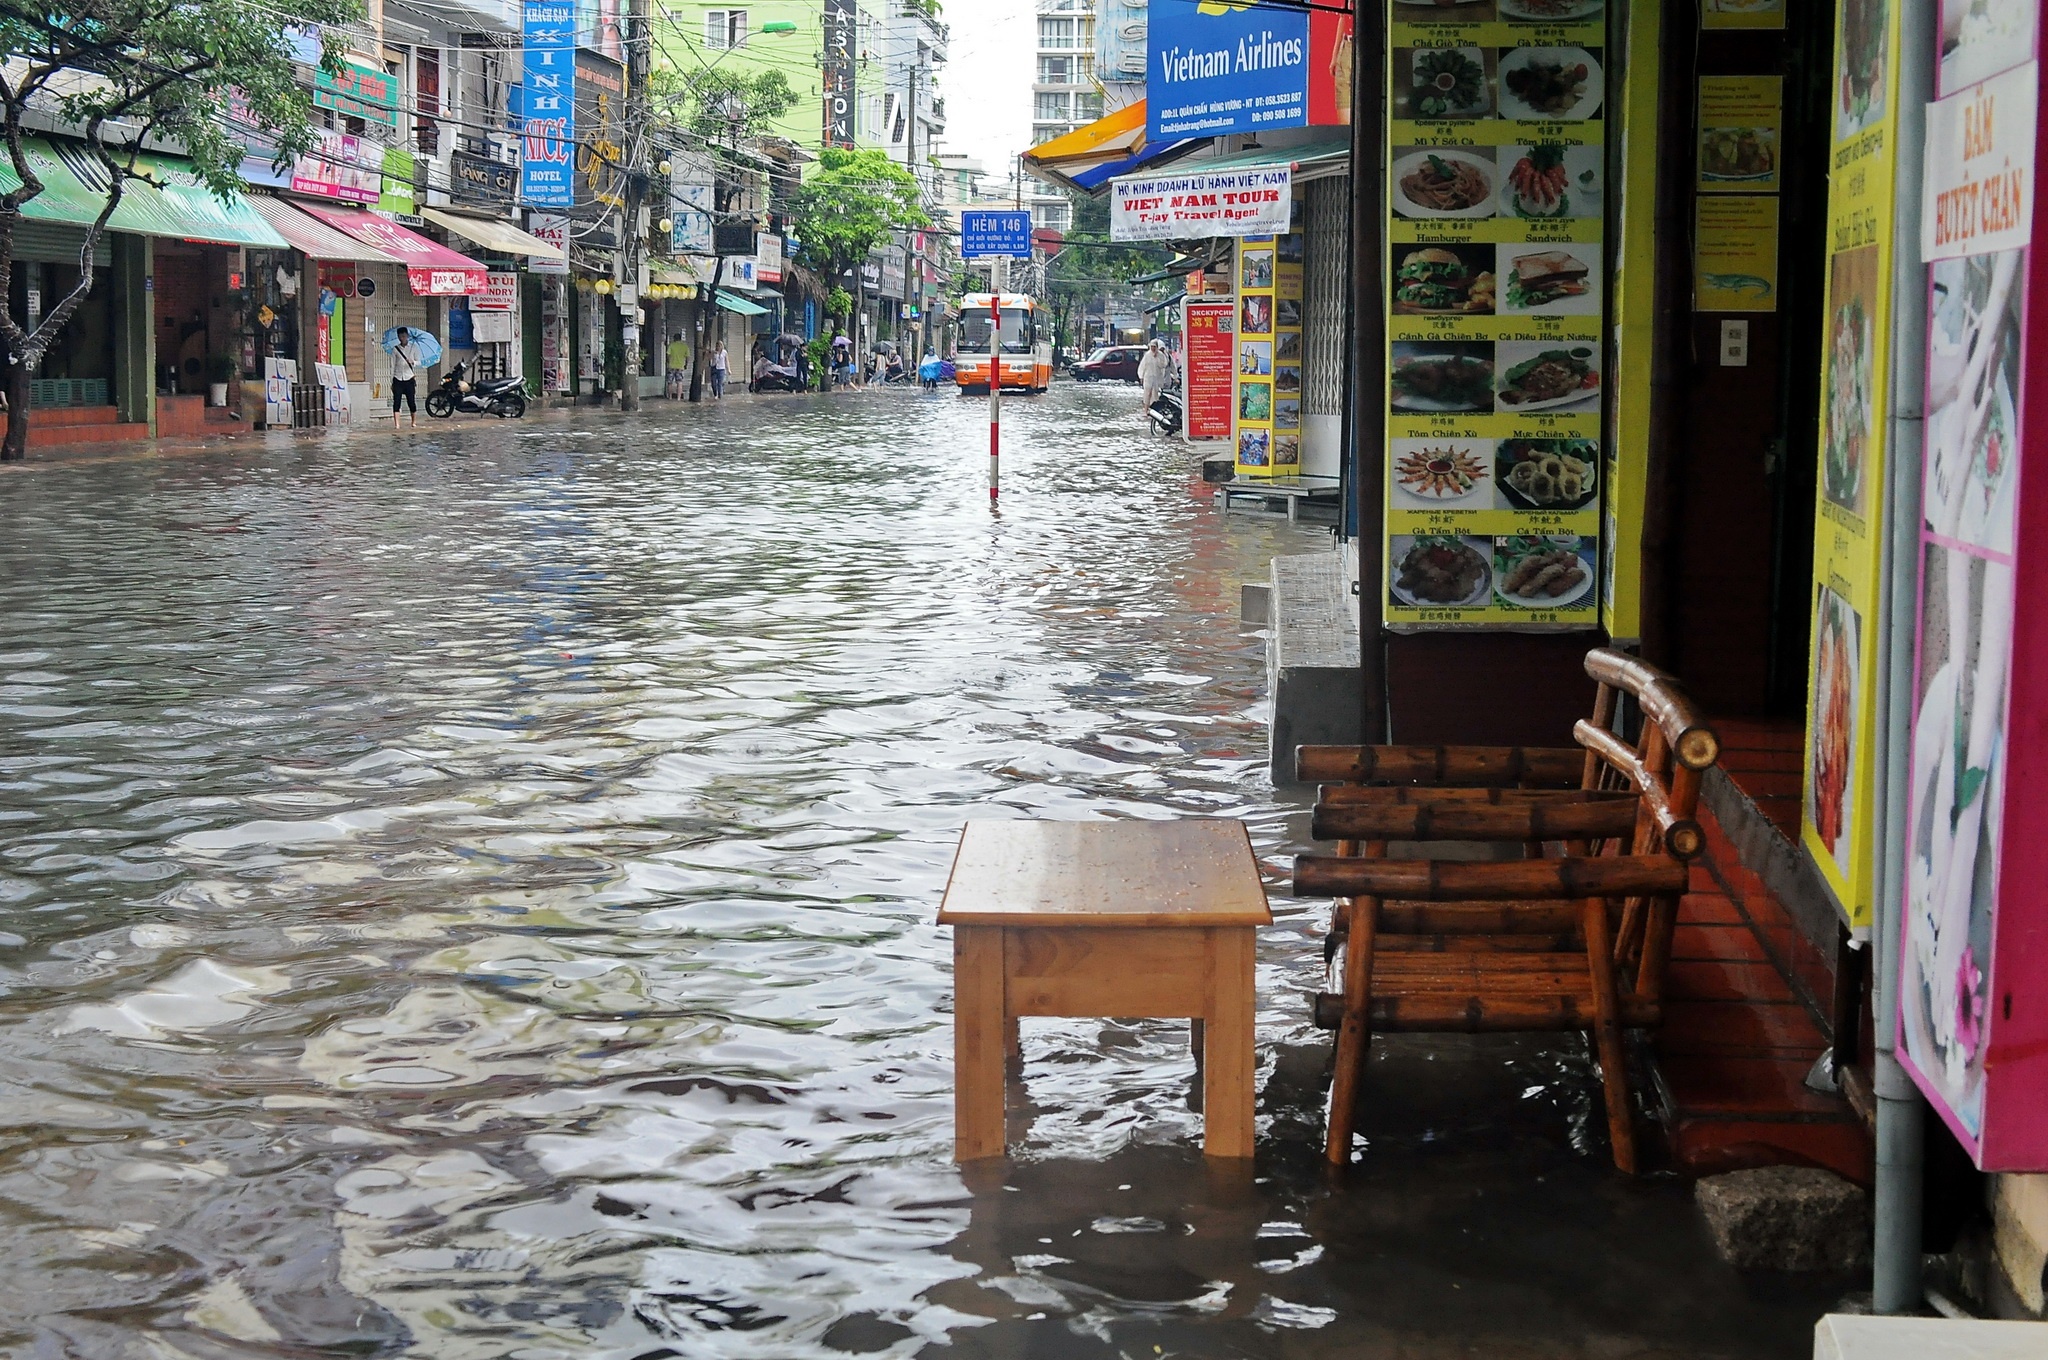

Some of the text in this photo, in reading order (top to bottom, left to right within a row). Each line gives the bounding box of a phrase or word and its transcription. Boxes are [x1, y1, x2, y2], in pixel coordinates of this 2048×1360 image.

[526, 5, 569, 25] KHÁCH SẠN
[1517, 39, 1531, 47] Gà
[1162, 31, 1301, 83] Vietnam Airlines
[532, 29, 563, 109] XINH
[525, 116, 569, 166] NICE
[530, 171, 562, 181] HOTEL
[1117, 183, 1130, 196] HỘ
[1133, 183, 1154, 195] KINH
[1157, 181, 1189, 193] DOANH
[1209, 175, 1235, 189] HÀNH
[1239, 172, 1261, 189] VIỆT
[1263, 172, 1288, 185] NAM
[1123, 189, 1280, 212] VIET NAM TOUR
[1139, 208, 1259, 224] T-jay Travel Agent
[972, 214, 1021, 232] HẺM 146
[1417, 234, 1471, 243] Hamburger
[1525, 234, 1572, 242] Sandwich
[487, 288, 514, 296] NDRY
[1398, 332, 1488, 340] Cánh Gà Chiên Bơ
[1499, 332, 1511, 341] Cá
[1539, 331, 1564, 342] Hồng
[1407, 430, 1477, 438] Tôm Chiên Xù
[1536, 430, 1565, 438] Chiên
[1568, 430, 1581, 438] Xù
[1412, 527, 1426, 535] Gà
[1454, 526, 1471, 536] Bột
[1516, 527, 1529, 535] Cá
[1558, 526, 1574, 536] Bột
